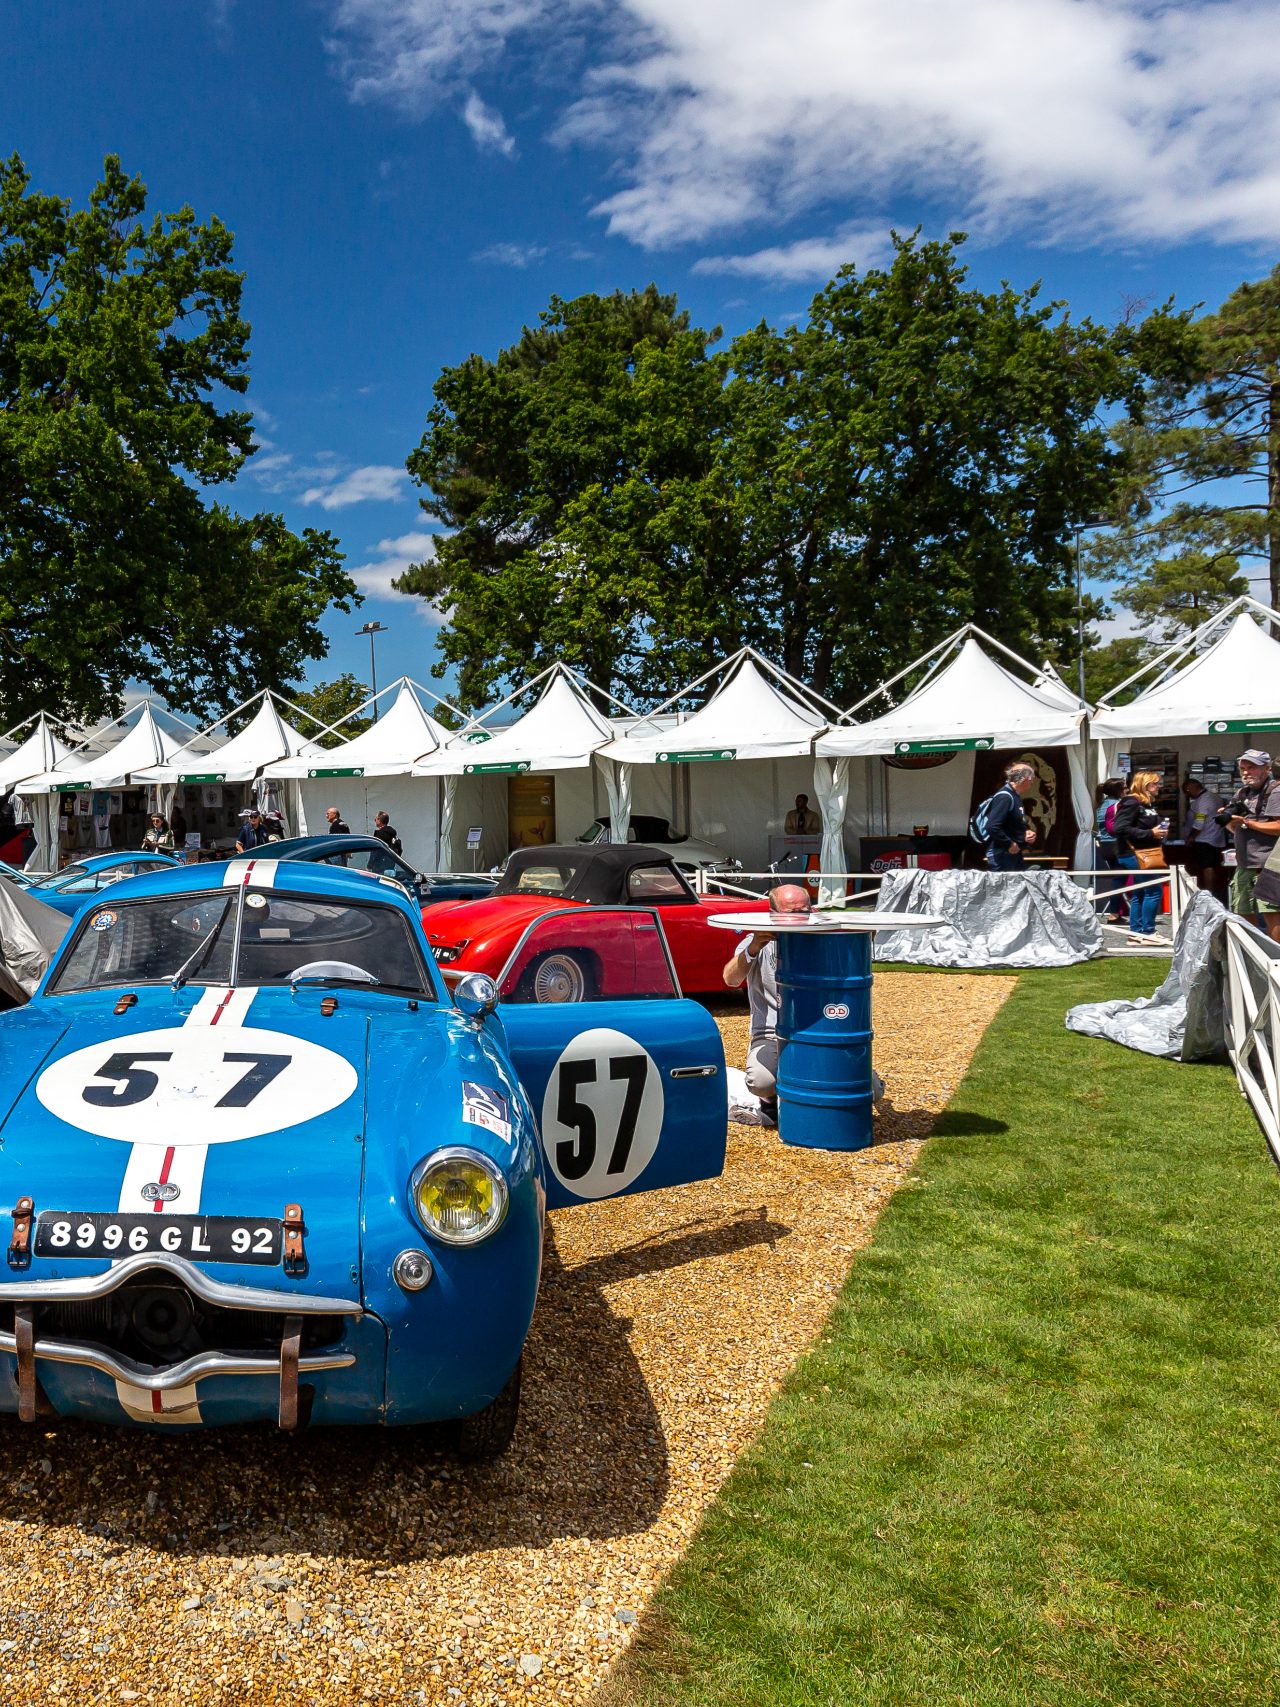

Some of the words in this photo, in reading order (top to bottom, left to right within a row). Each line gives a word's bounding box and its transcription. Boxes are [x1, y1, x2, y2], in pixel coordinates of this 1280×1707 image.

[555, 1054, 649, 1181] 57
[49, 1221, 149, 1252] 8996
[160, 1226, 211, 1253] GL
[230, 1227, 274, 1255] 92
